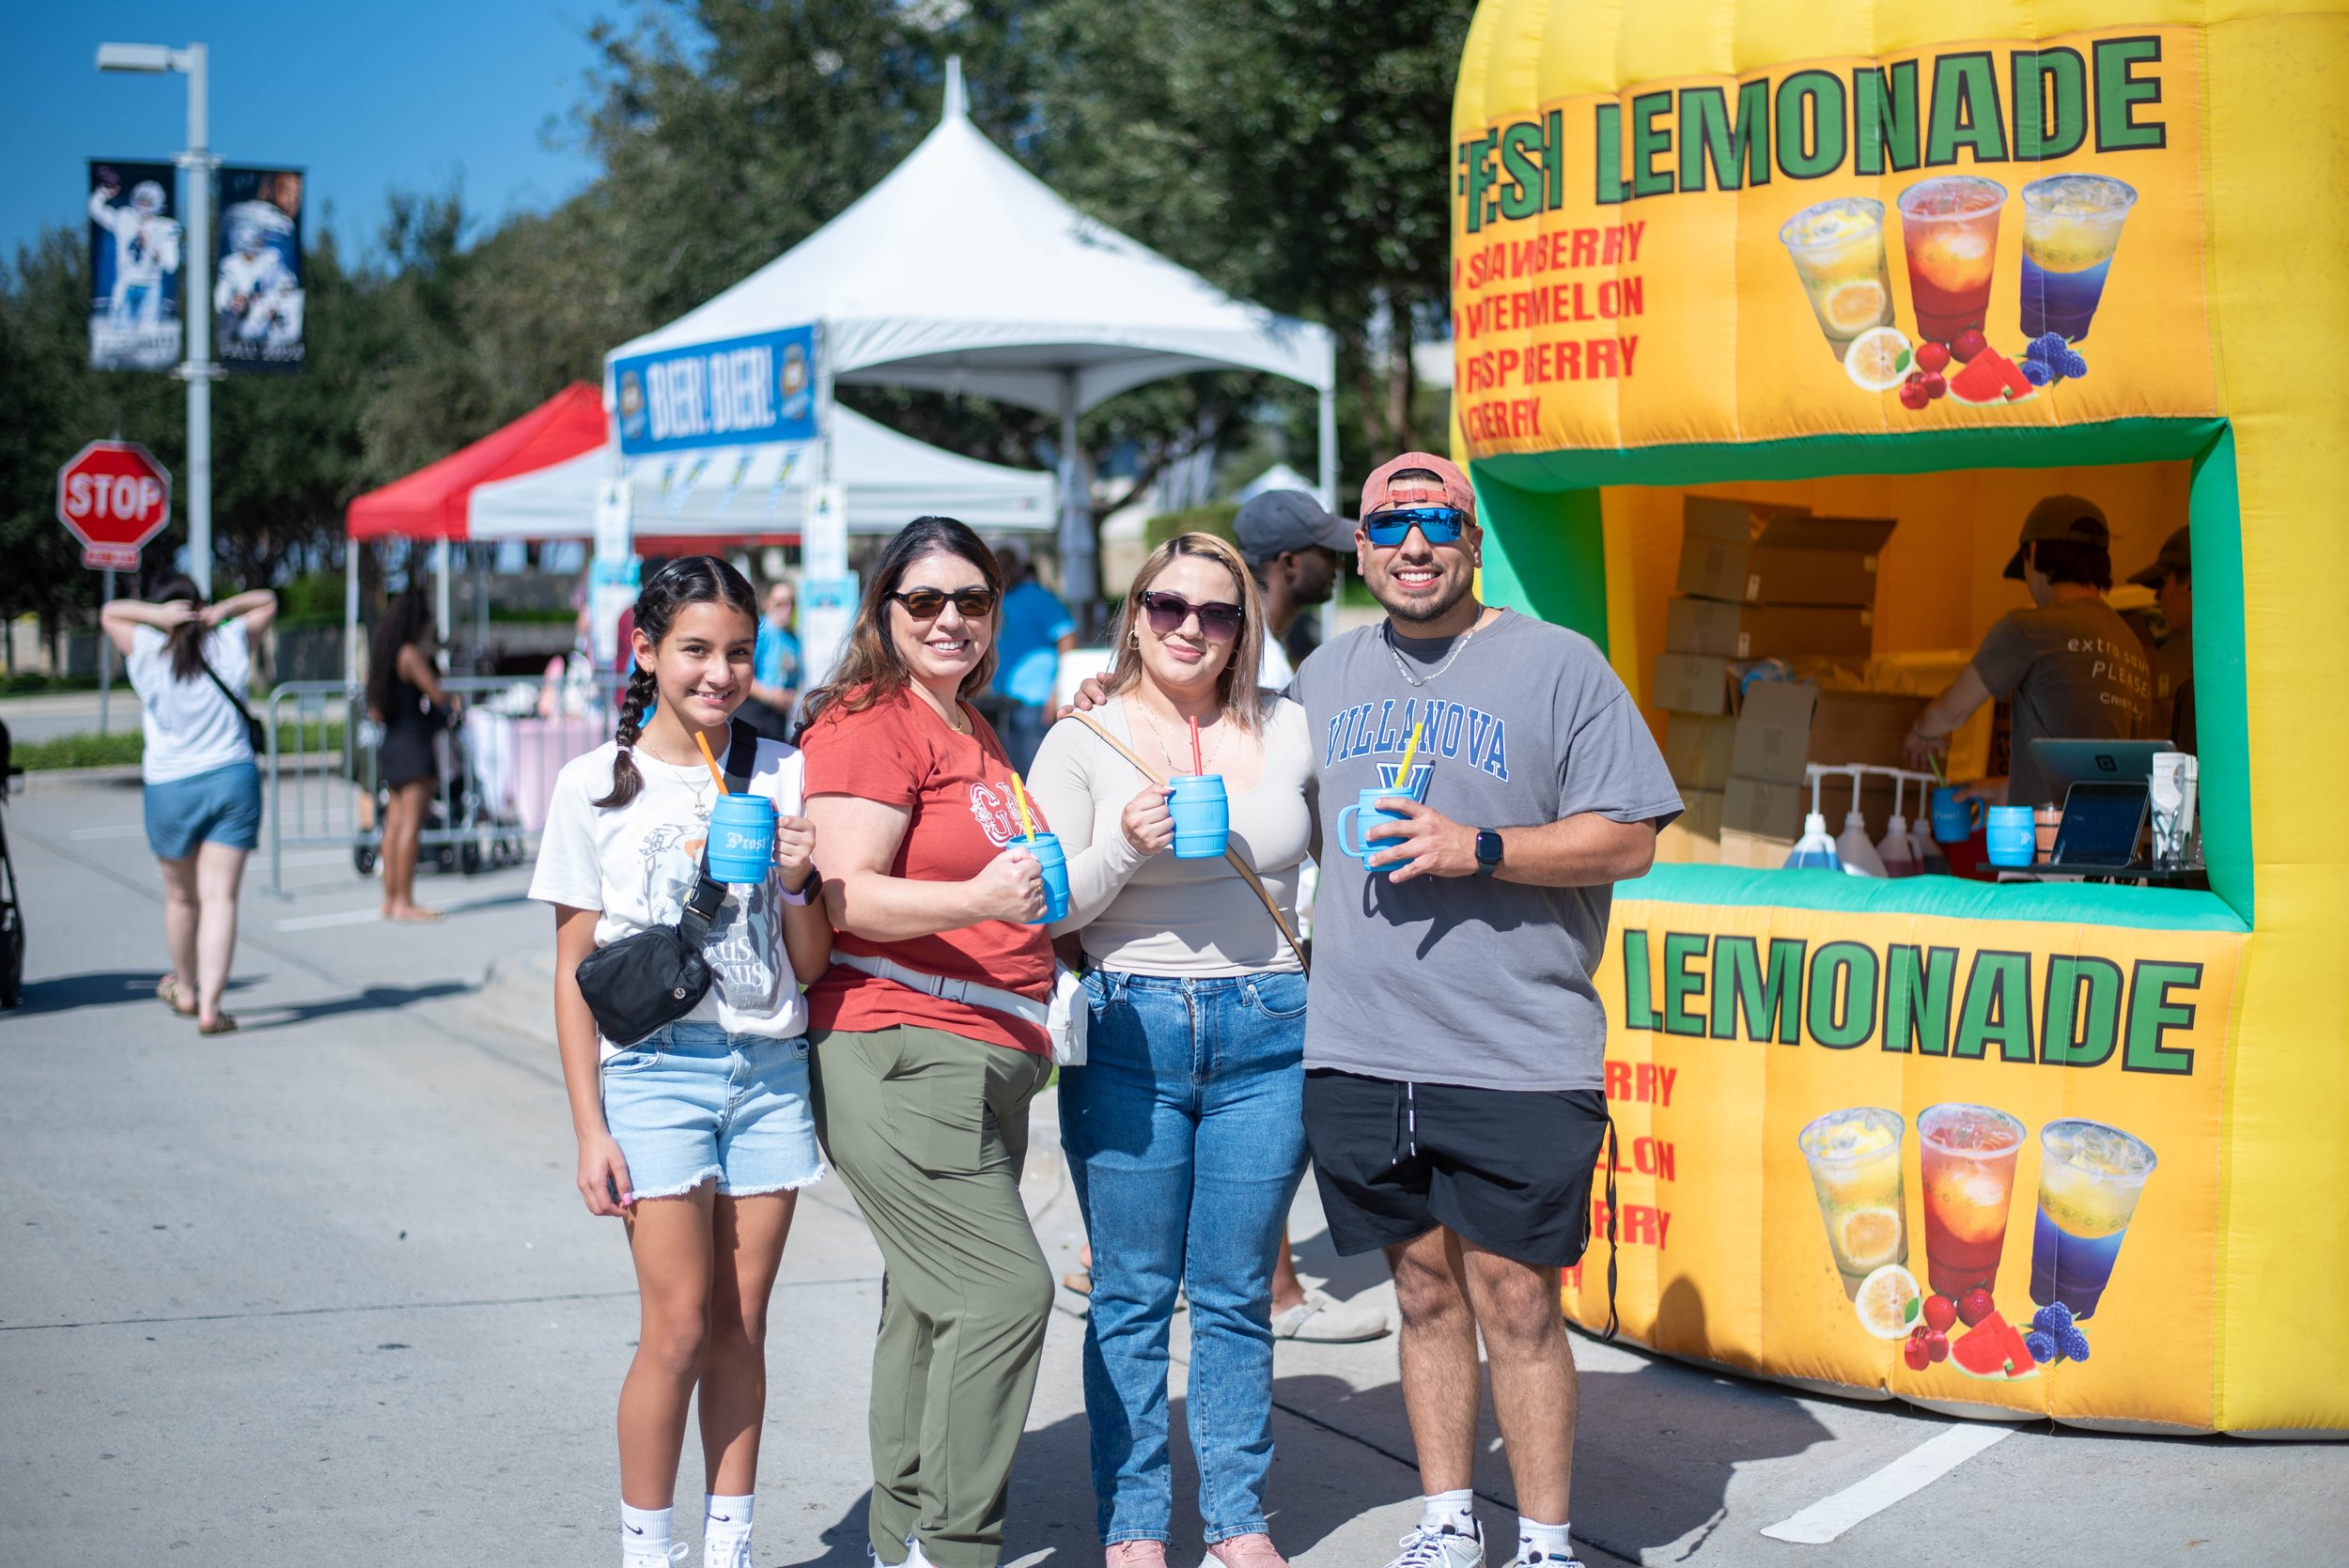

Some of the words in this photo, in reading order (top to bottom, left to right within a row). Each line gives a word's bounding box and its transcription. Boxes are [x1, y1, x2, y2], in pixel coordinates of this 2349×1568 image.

[1595, 35, 2167, 206] LEMONADE
[67, 472, 162, 522] STOP
[2067, 637, 2121, 658] extra
[1325, 697, 1509, 784] VILLANOVA
[1624, 928, 2204, 1077] LEMONADE
